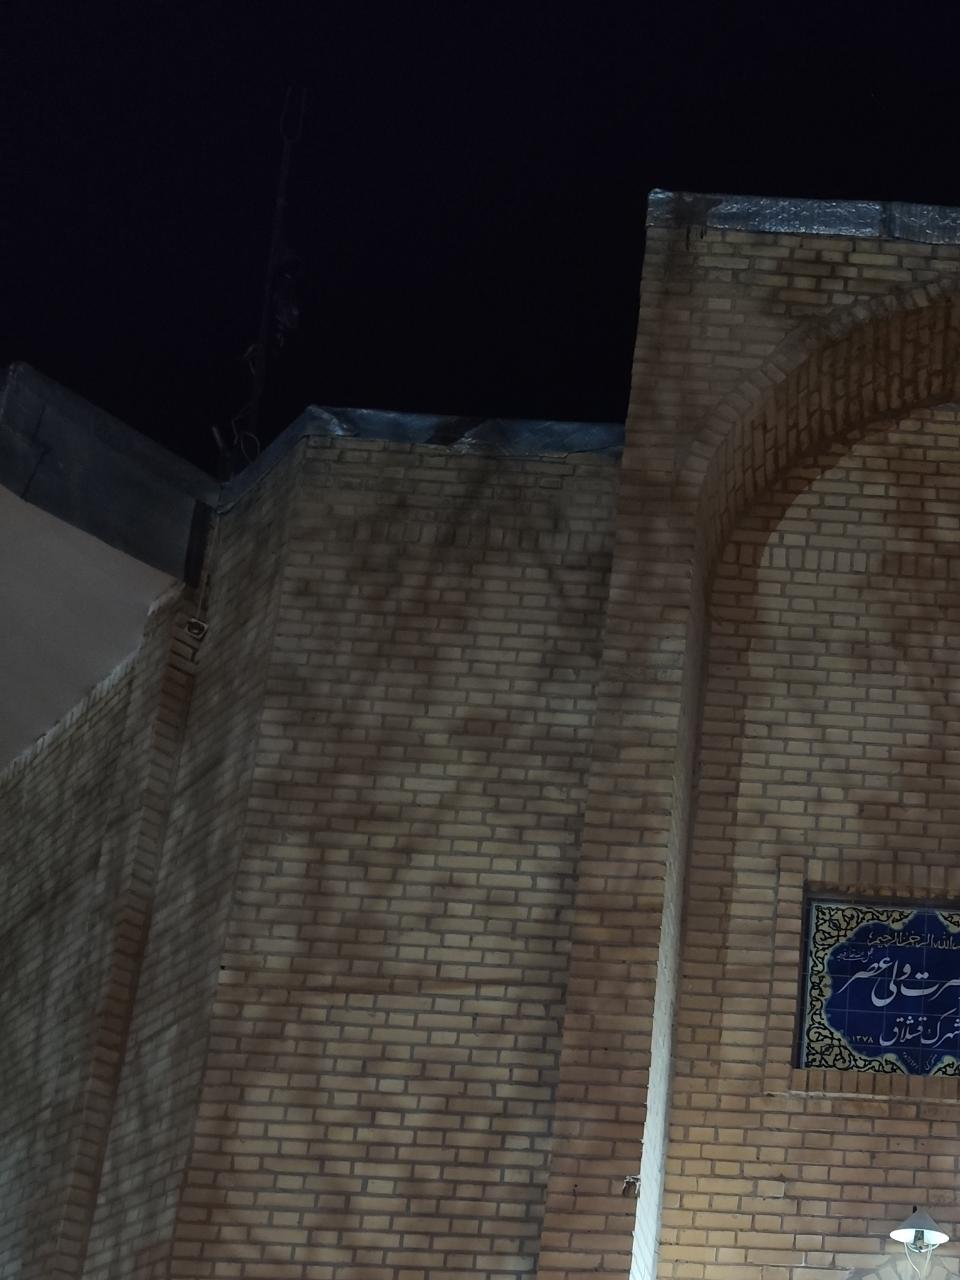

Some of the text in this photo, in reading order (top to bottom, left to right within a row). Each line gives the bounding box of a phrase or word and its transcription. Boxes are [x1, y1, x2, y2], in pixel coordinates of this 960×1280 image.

[933, 931, 953, 950] الله
[837, 956, 892, 994] عصر
[870, 959, 912, 1007] ولی
[879, 1015, 928, 1047] قشلاق
